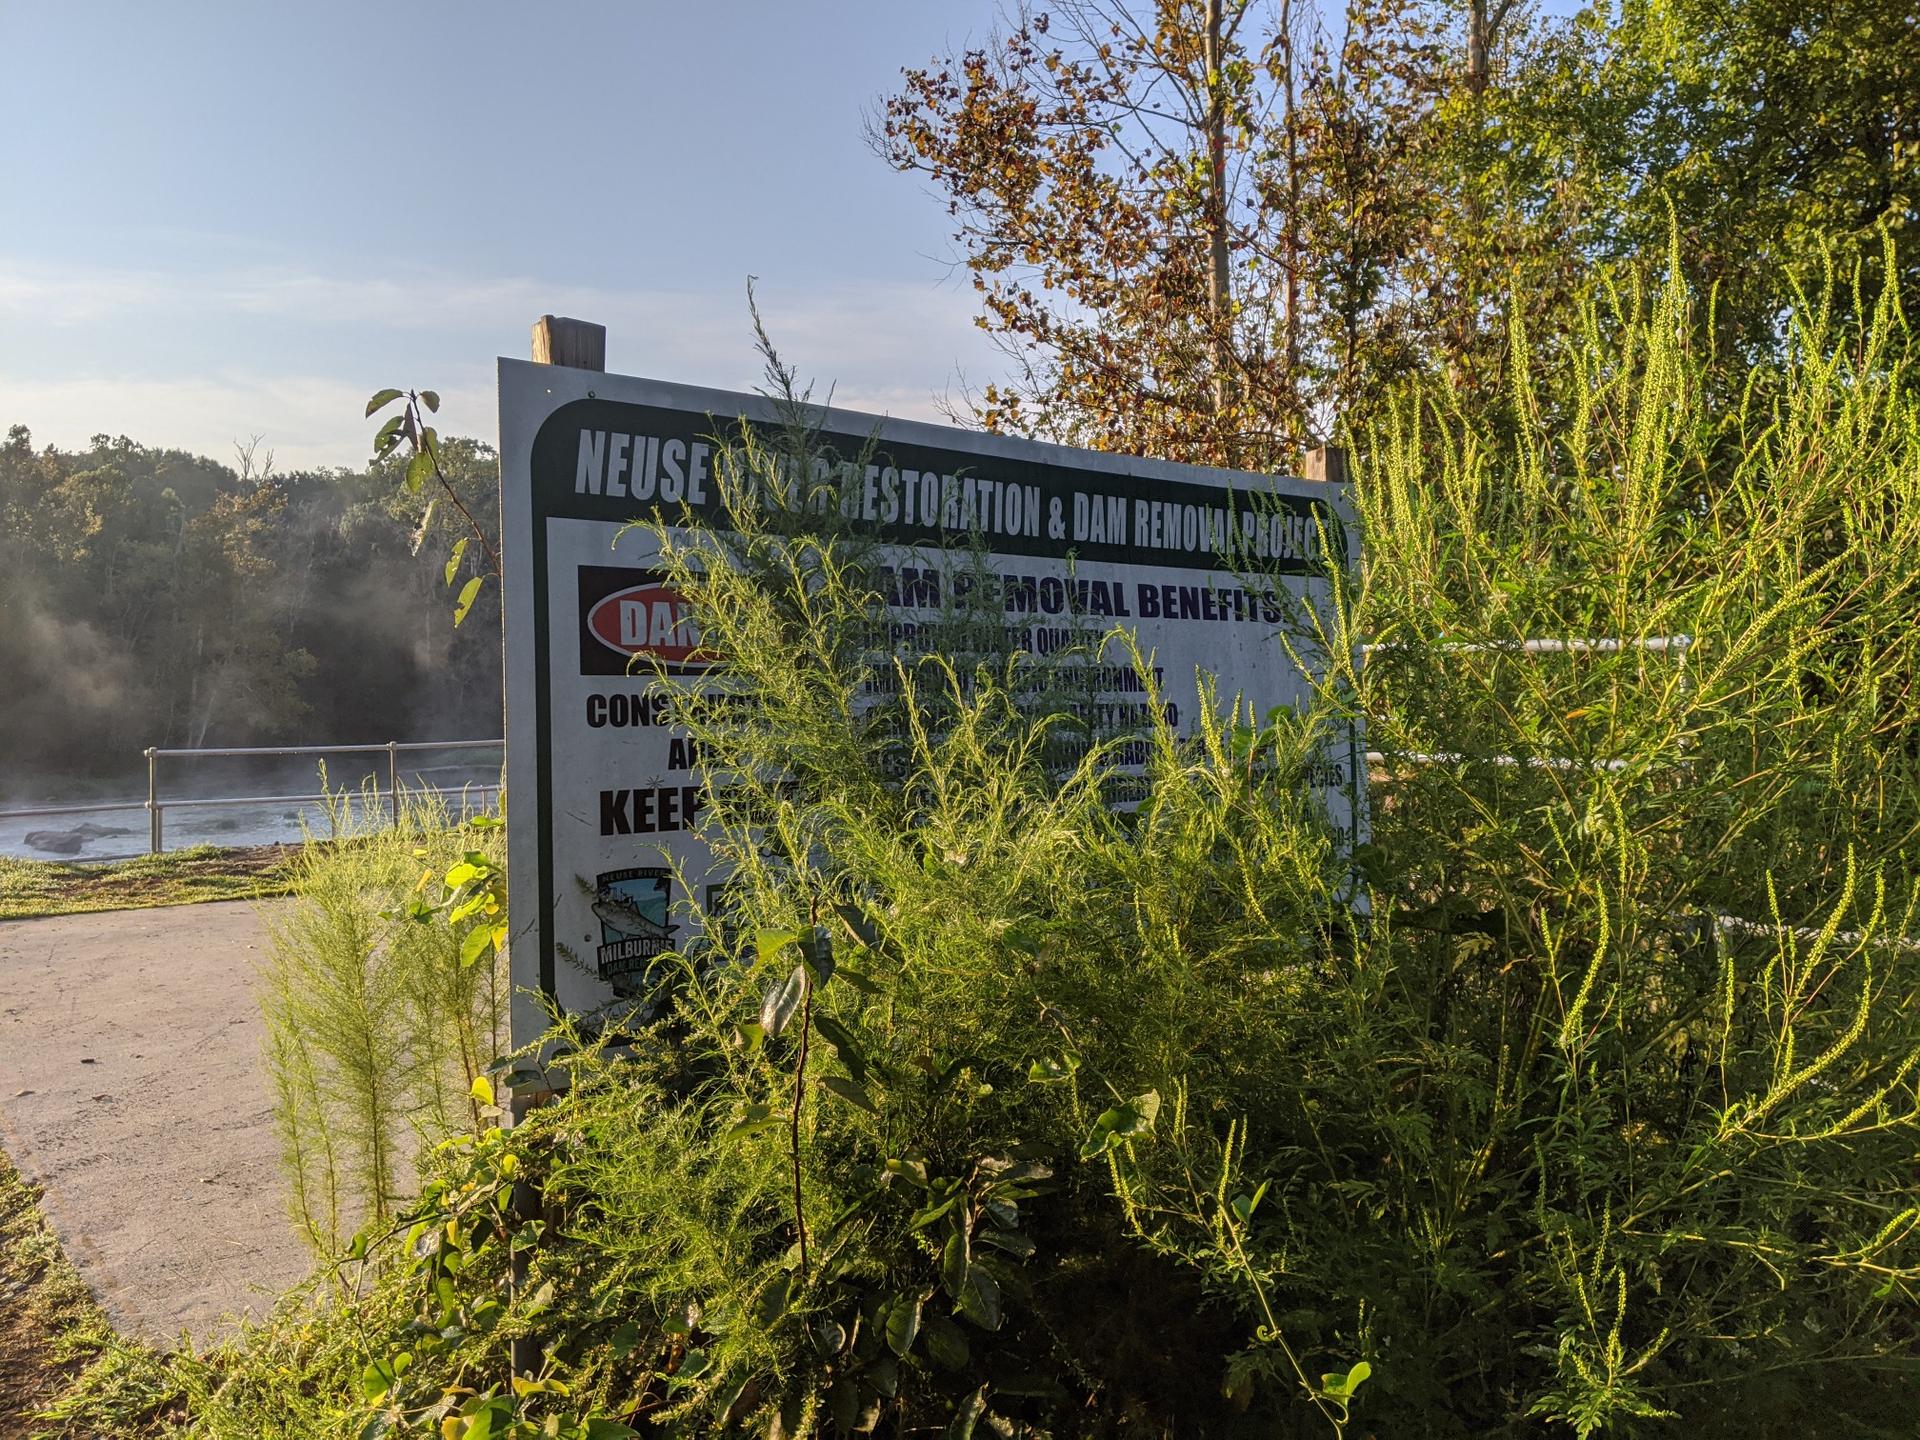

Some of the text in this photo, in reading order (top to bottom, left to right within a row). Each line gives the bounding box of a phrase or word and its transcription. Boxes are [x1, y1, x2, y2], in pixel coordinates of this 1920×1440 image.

[575, 429, 710, 505] NEUSE
[1048, 496, 1066, 540] &
[1073, 491, 1127, 545] DAM
[1135, 499, 1236, 554] REMOVAL
[1242, 510, 1328, 562] PROJEC
[600, 786, 707, 836] KEEP
